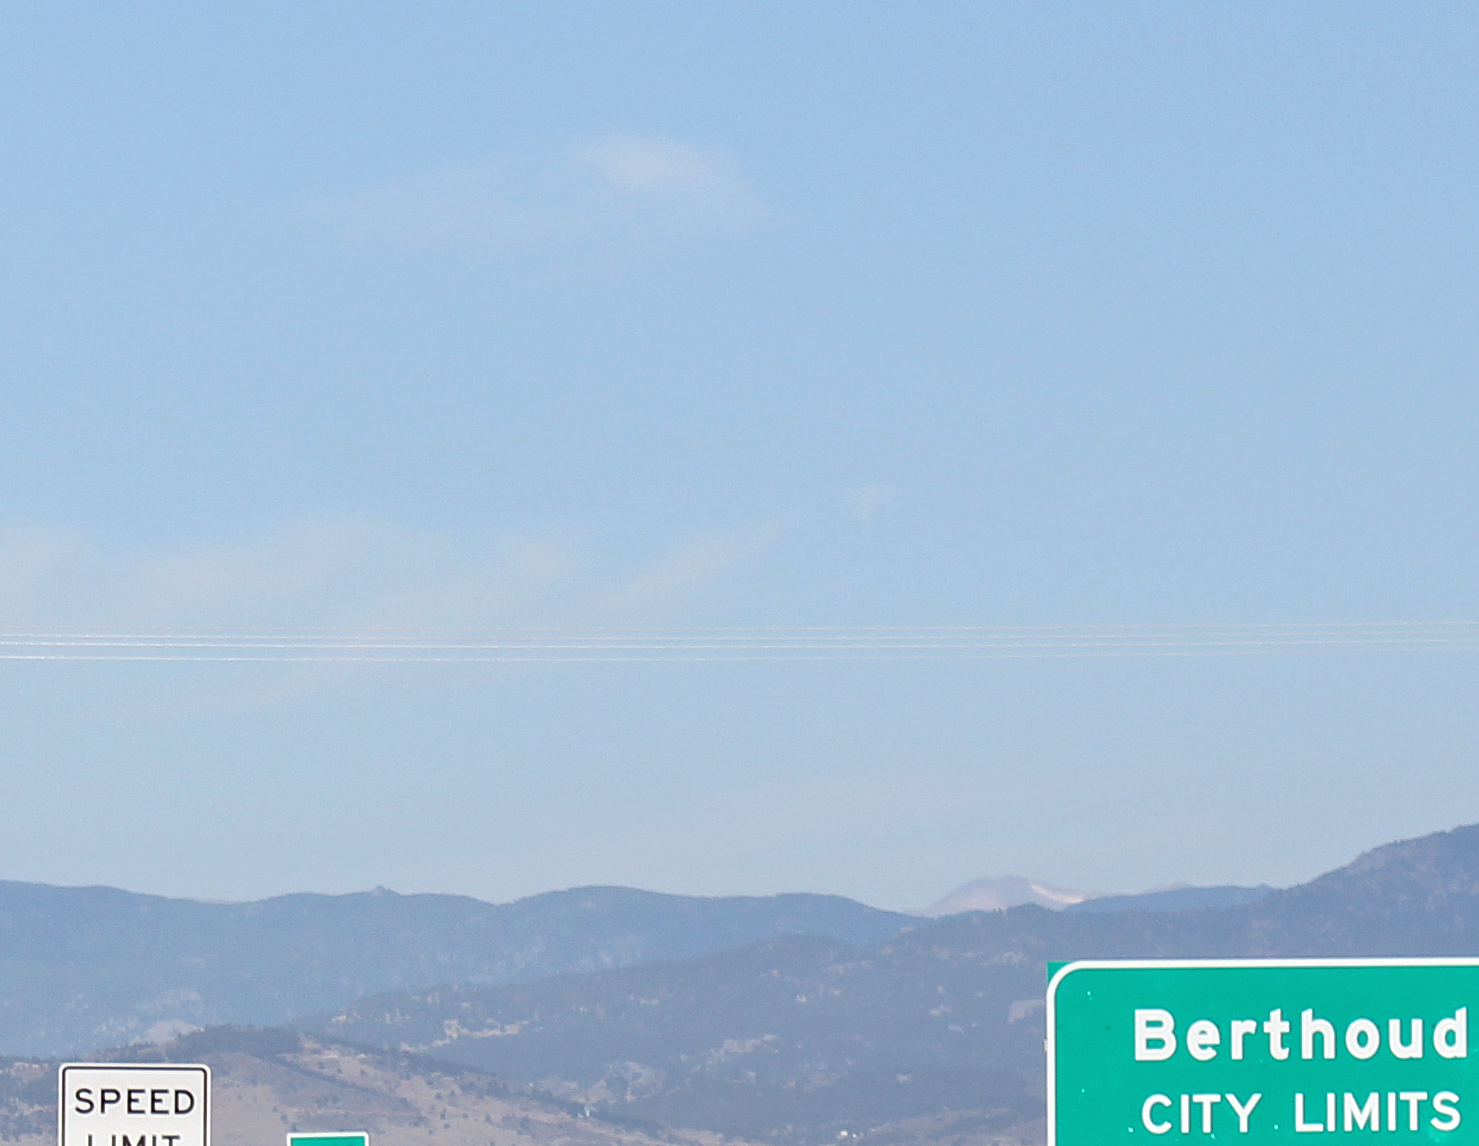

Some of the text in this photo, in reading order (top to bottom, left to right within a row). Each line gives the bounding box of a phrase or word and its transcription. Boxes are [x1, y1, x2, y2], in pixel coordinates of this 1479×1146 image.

[1134, 1006, 1468, 1061] Berthoud
[75, 1088, 195, 1115] SPEED
[1141, 1091, 1461, 1134] CITY LIMITS
